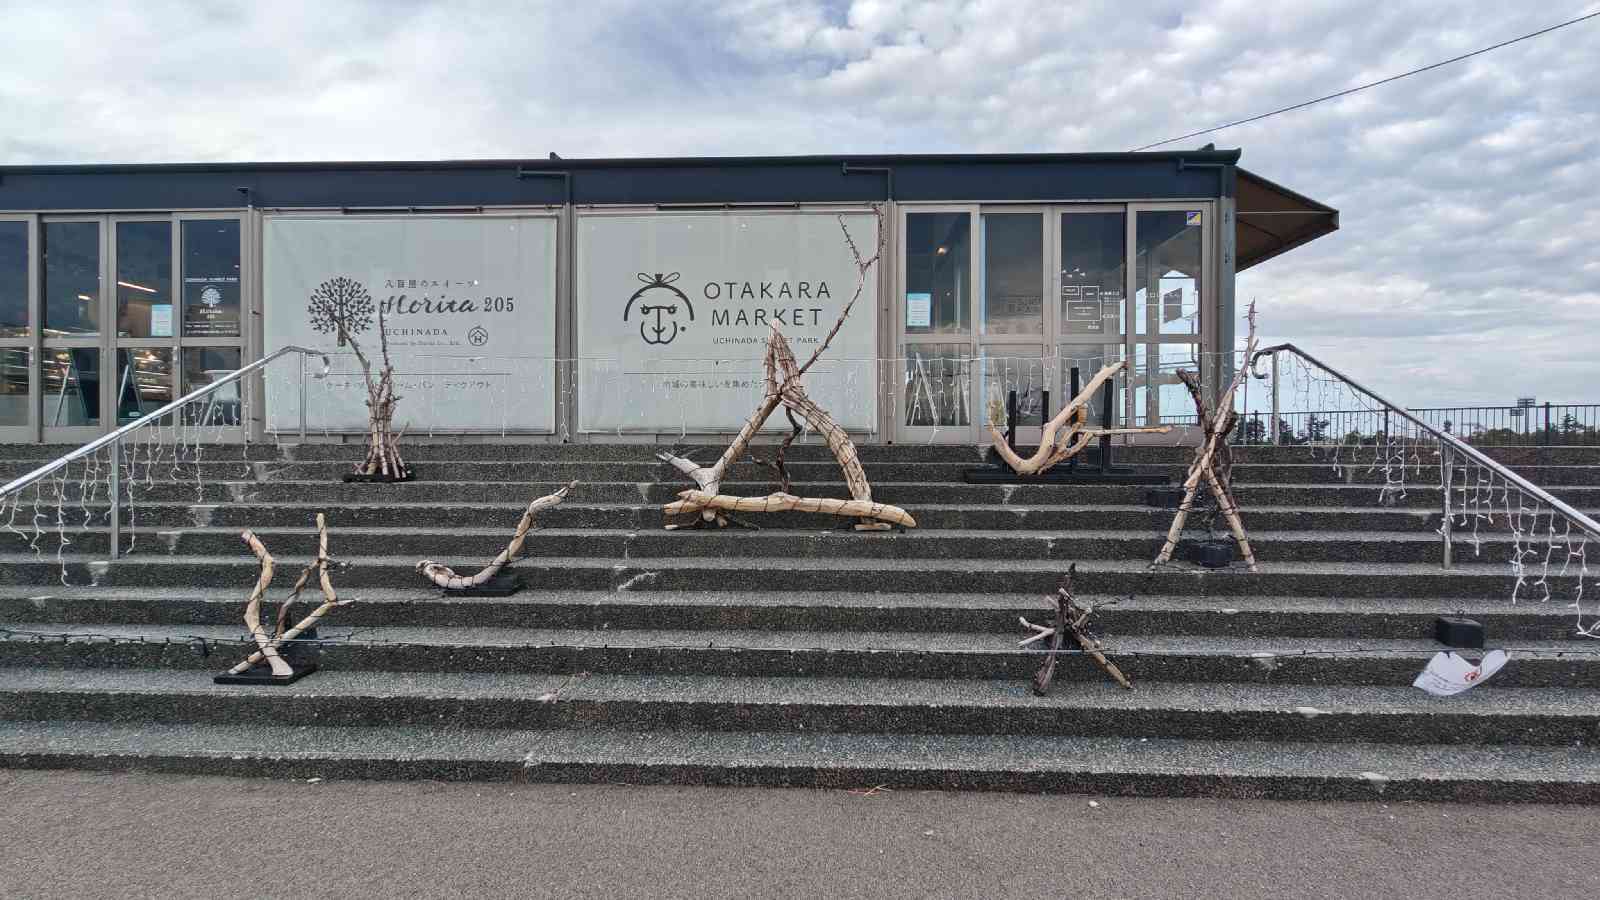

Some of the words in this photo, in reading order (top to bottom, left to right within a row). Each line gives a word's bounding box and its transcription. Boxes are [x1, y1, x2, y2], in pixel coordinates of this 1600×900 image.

[704, 281, 831, 300] OTAKARA
[483, 296, 514, 312] 205
[711, 308, 823, 326] MARKET
[384, 328, 448, 336] UCHINADA
